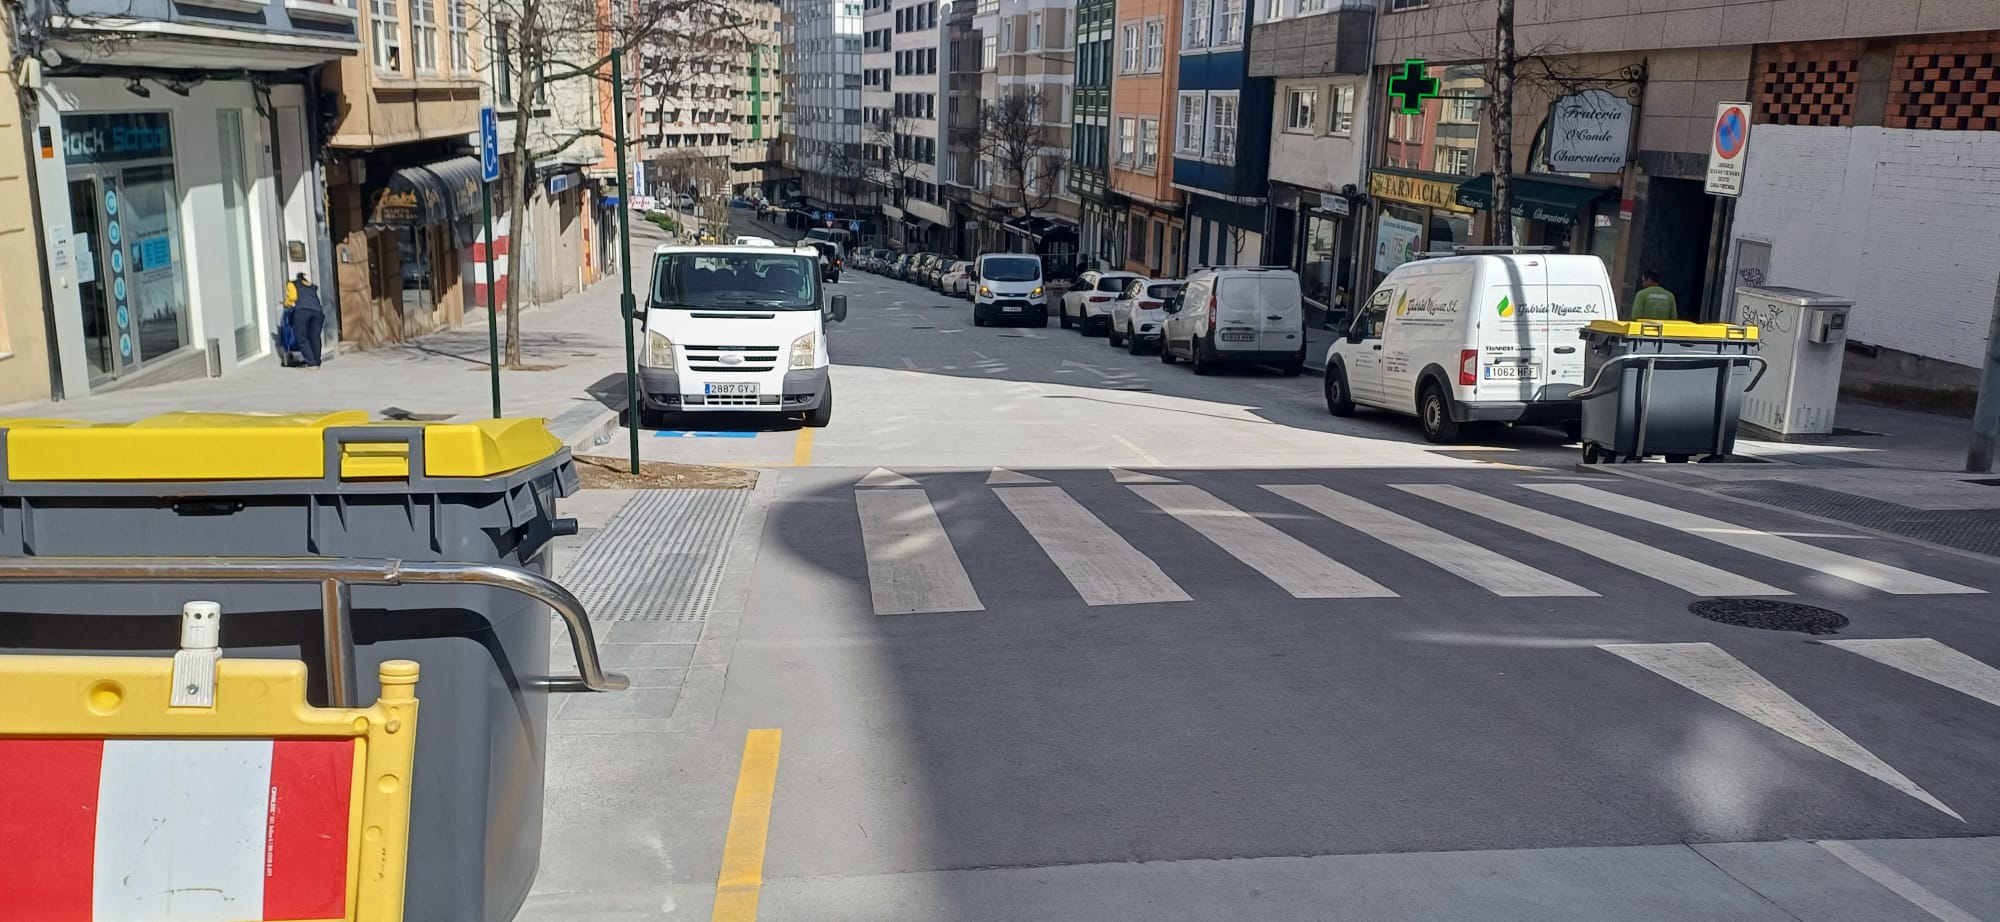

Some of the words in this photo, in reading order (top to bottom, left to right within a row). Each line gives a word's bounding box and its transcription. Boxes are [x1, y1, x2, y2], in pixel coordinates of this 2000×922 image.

[1563, 105, 1622, 120] Frutería
[1566, 129, 1612, 142] O'Conde
[1553, 150, 1621, 163] Charcutería
[1385, 177, 1442, 204] FARMACIA
[1458, 195, 1483, 208] Frutería
[1533, 207, 1570, 225] Charcutería
[1406, 298, 1427, 315] Gabriel
[1517, 303, 1549, 316] Gabriel
[1492, 368, 1515, 376] 1062
[1517, 368, 1535, 376] HFF
[711, 384, 735, 393] 2887
[738, 384, 756, 393] GYJ
